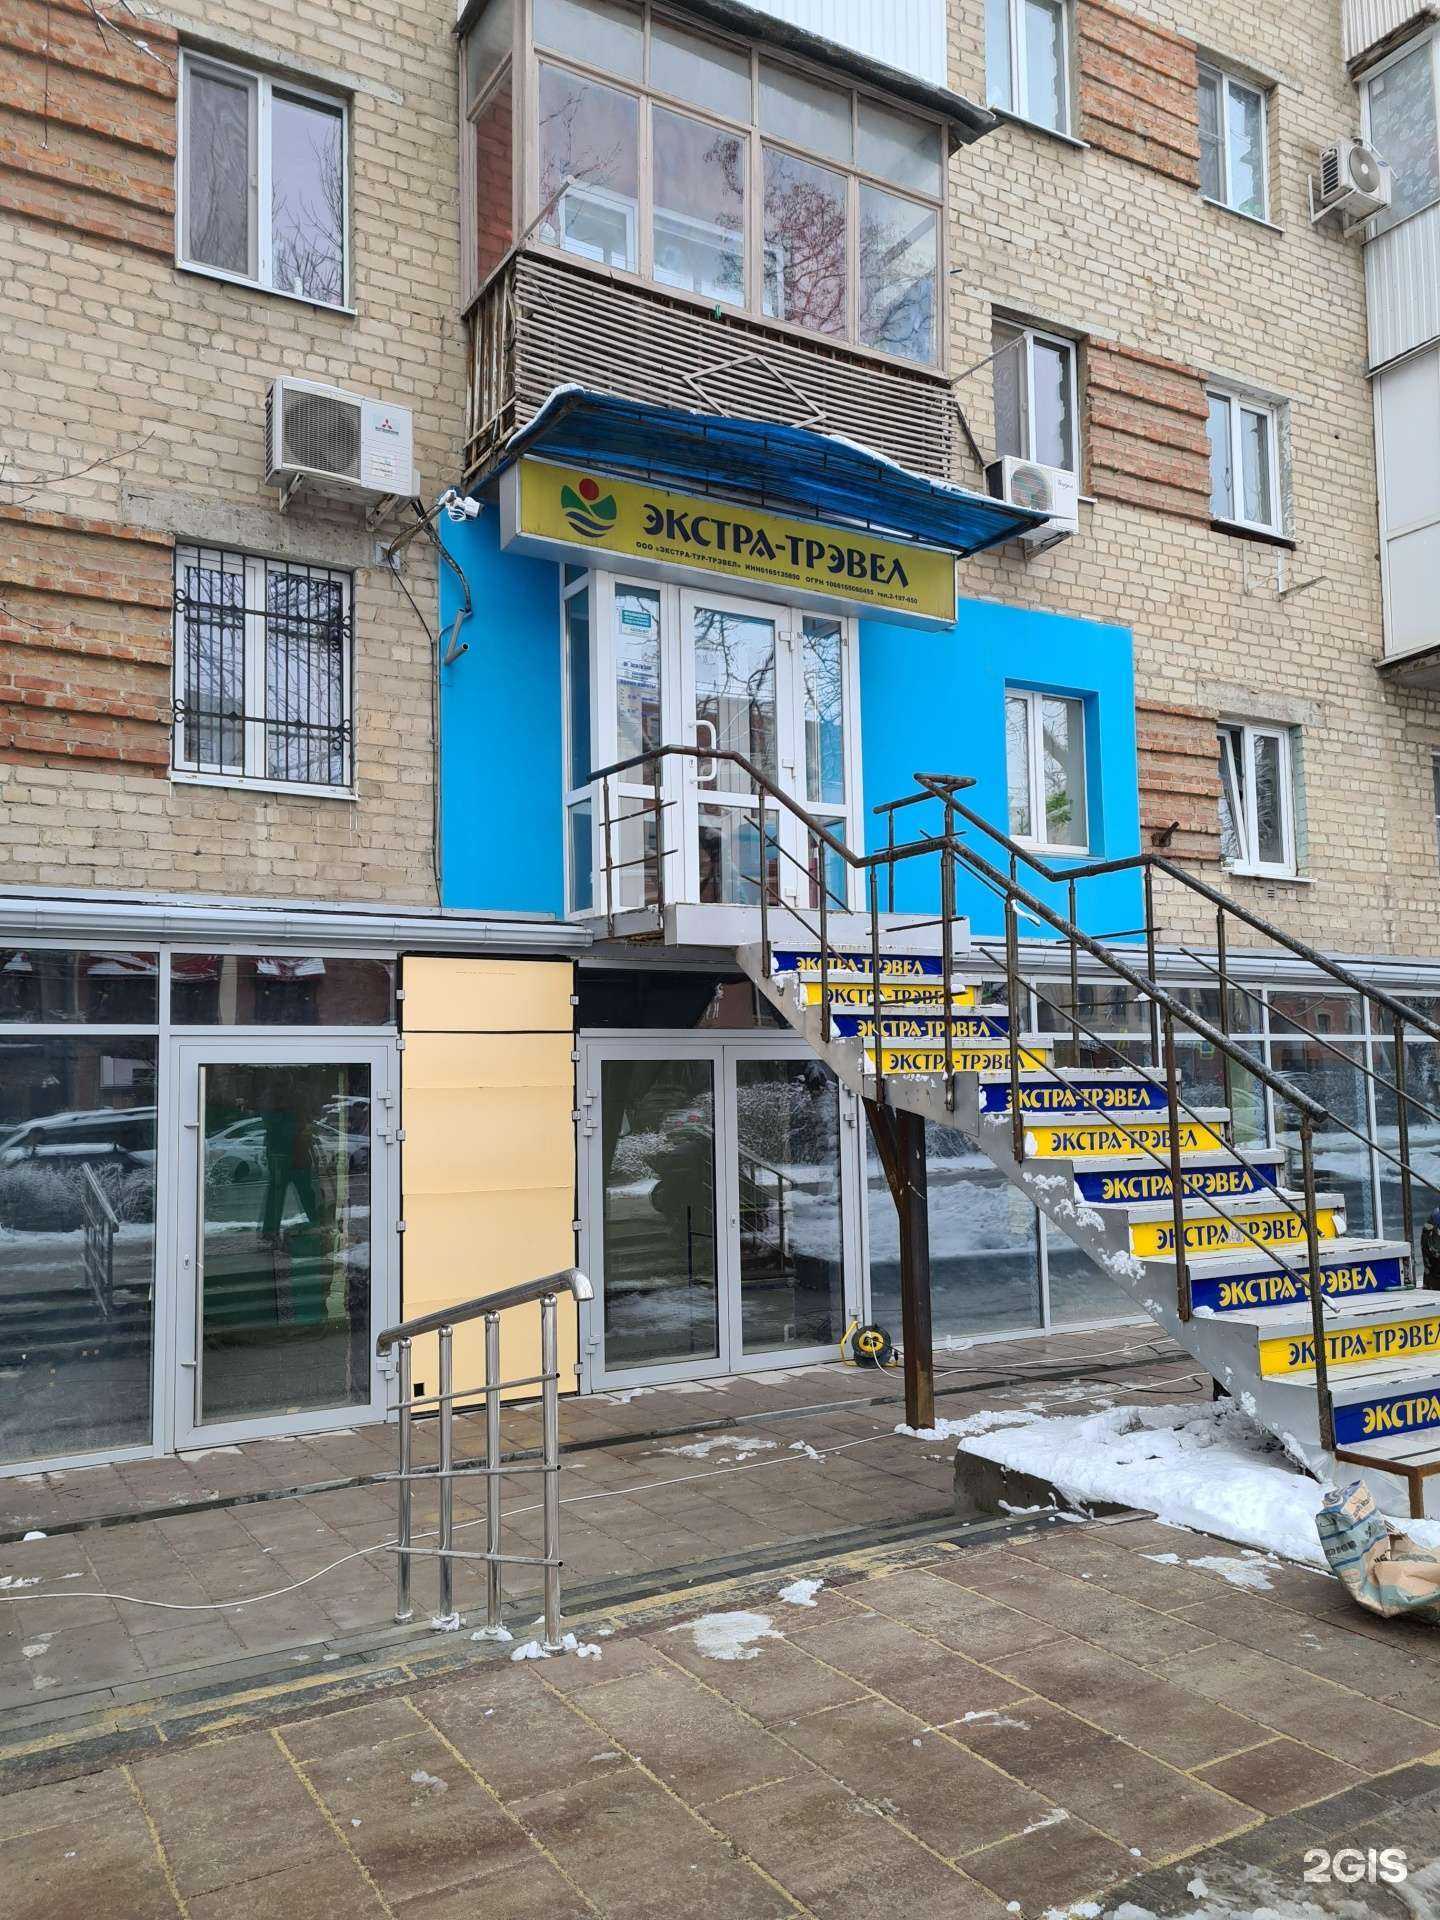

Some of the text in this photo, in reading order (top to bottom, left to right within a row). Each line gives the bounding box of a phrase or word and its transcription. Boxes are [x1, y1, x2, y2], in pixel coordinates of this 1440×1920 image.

[636, 541, 653, 551] ООО
[805, 576, 824, 586] ОГРН
[643, 503, 909, 587] ЭКСТРА-ТРЭВЕЛ
[1102, 1171, 1254, 1200] ЭКСТРАТРЭВЕЛ
[1288, 1322, 1440, 1366] ЭКТРА-ТРЭВЕ
